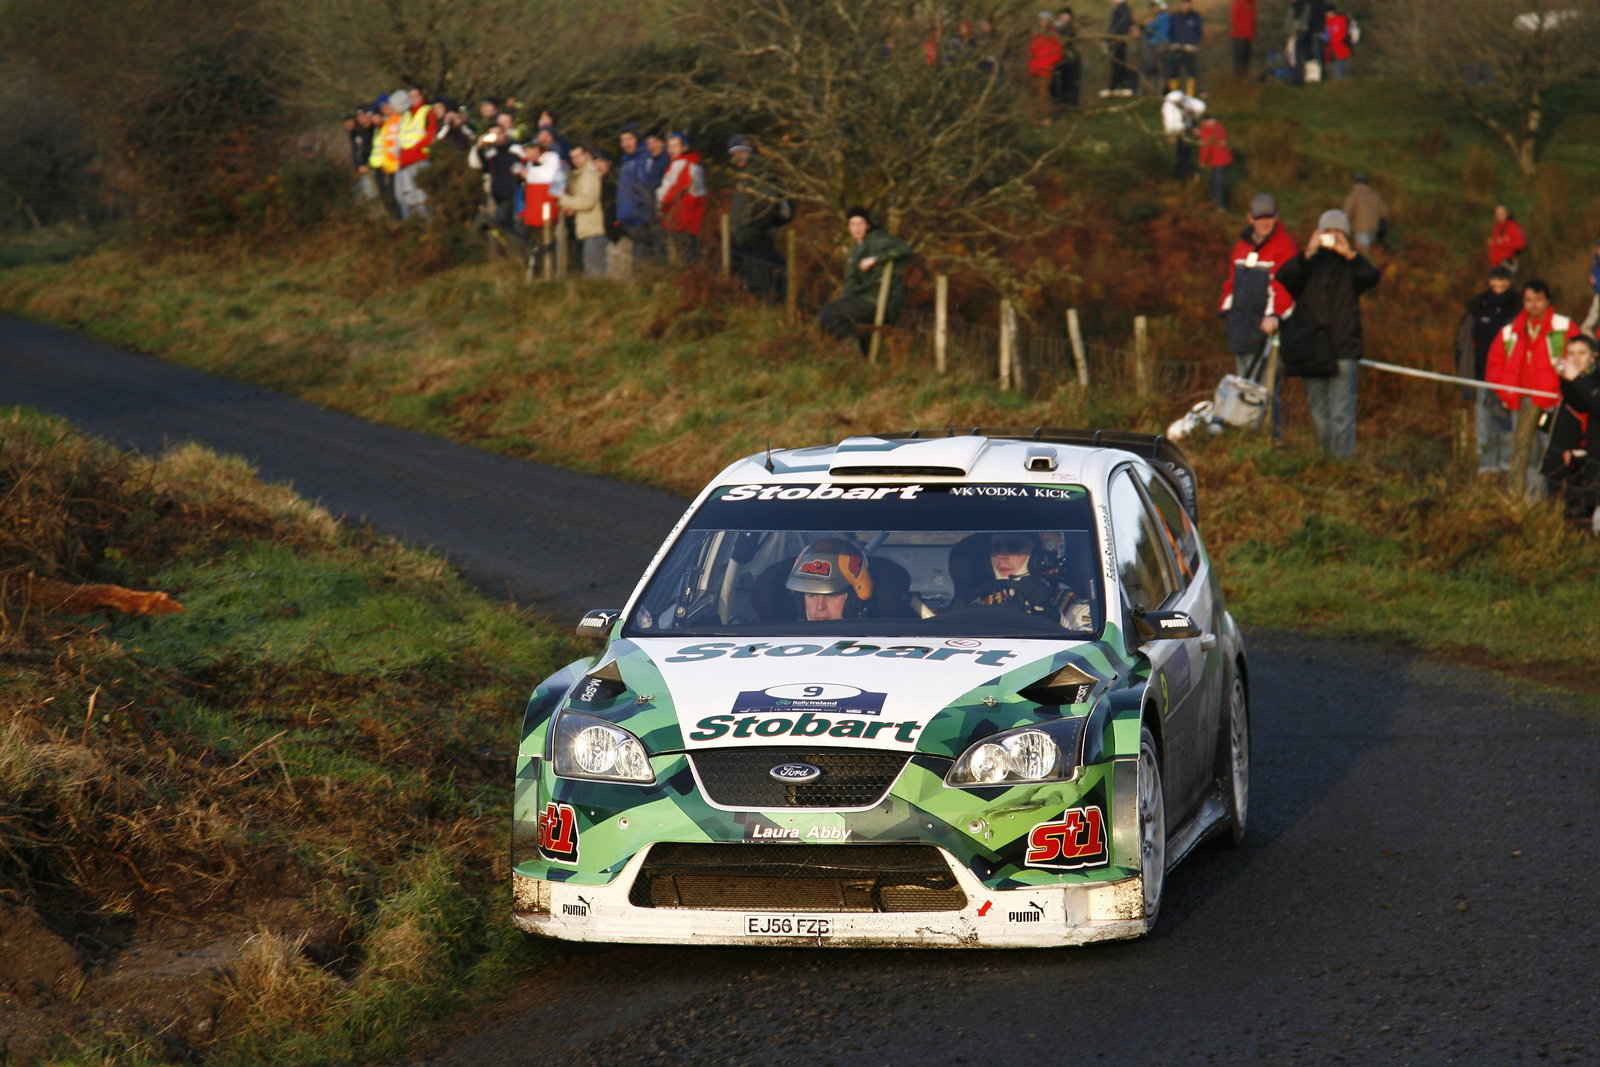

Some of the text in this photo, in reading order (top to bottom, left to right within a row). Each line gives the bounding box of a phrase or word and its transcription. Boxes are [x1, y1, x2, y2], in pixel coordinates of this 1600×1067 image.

[721, 483, 924, 500] Stobart
[952, 487, 1071, 499] VK VODKA KICK
[580, 618, 604, 627] PUMA
[1160, 618, 1188, 628] PUMA
[664, 640, 1018, 667] Stobart
[580, 678, 602, 702] M-SPO
[803, 686, 824, 697] 9
[689, 712, 922, 744] Stobart
[780, 765, 809, 778] Ford
[752, 824, 852, 842] Laura Abby
[1027, 809, 1103, 862] st1
[562, 904, 587, 917] PUMA
[1009, 911, 1040, 922] PUMA
[748, 918, 793, 934] EJ56
